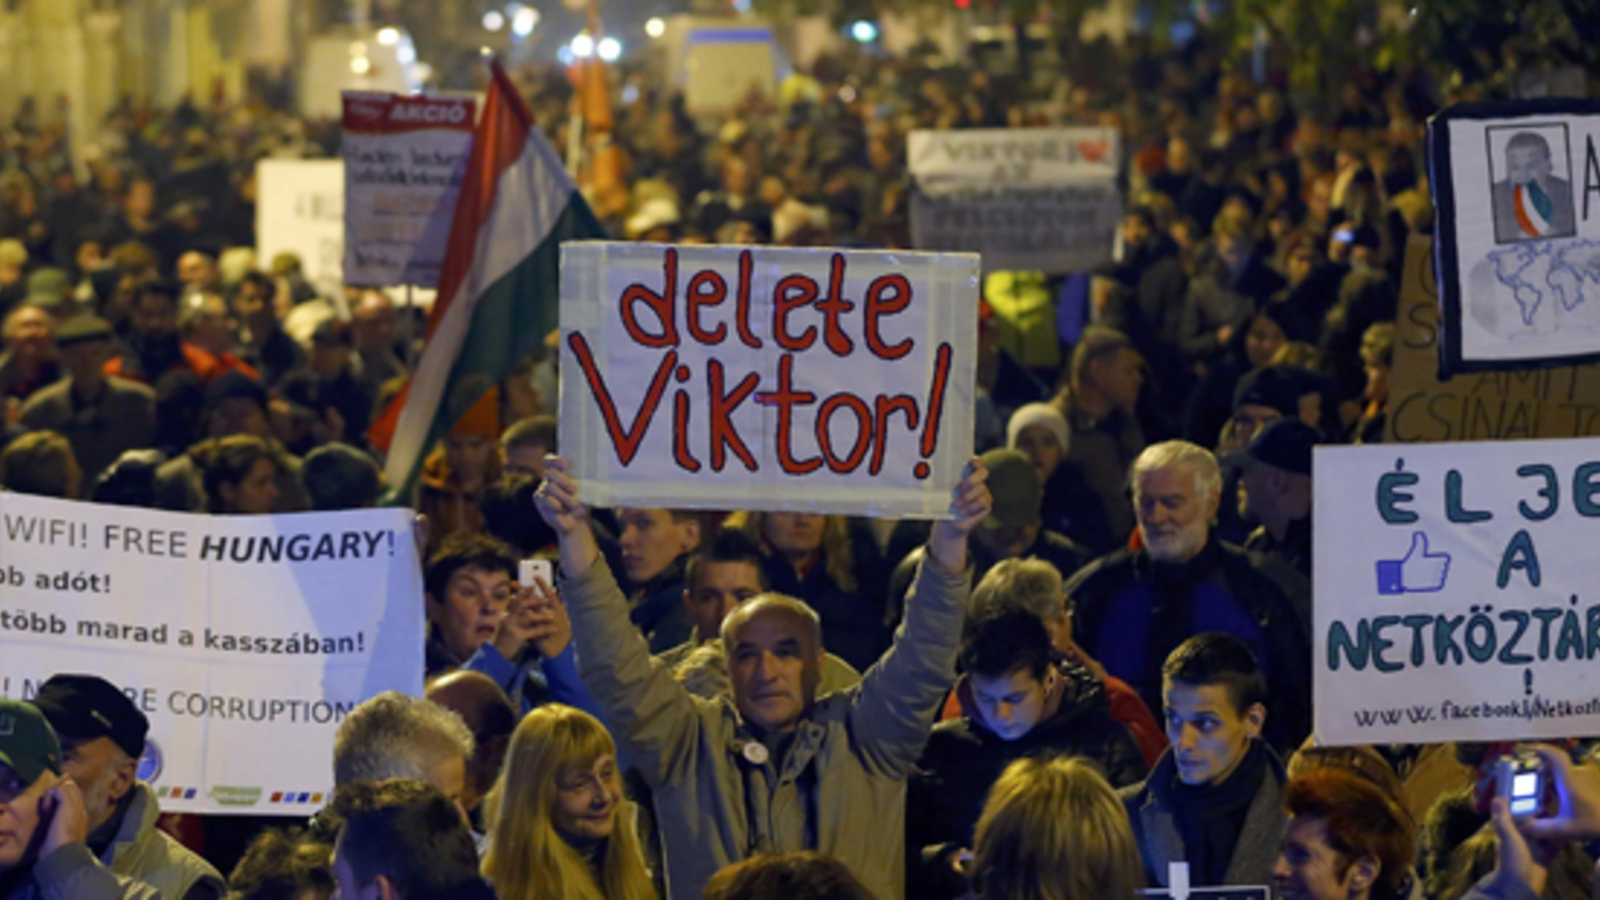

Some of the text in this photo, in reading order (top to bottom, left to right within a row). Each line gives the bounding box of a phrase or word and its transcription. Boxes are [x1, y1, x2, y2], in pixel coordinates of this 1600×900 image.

[390, 102, 466, 123] AKCIÓ
[619, 247, 914, 361] delete
[567, 330, 953, 480] Viktor!
[4, 513, 395, 562] WIFI! FREE HUNGARY!
[1497, 529, 1541, 589] A
[35, 571, 111, 593] adót!
[1, 610, 365, 655] több marad a kasszában!
